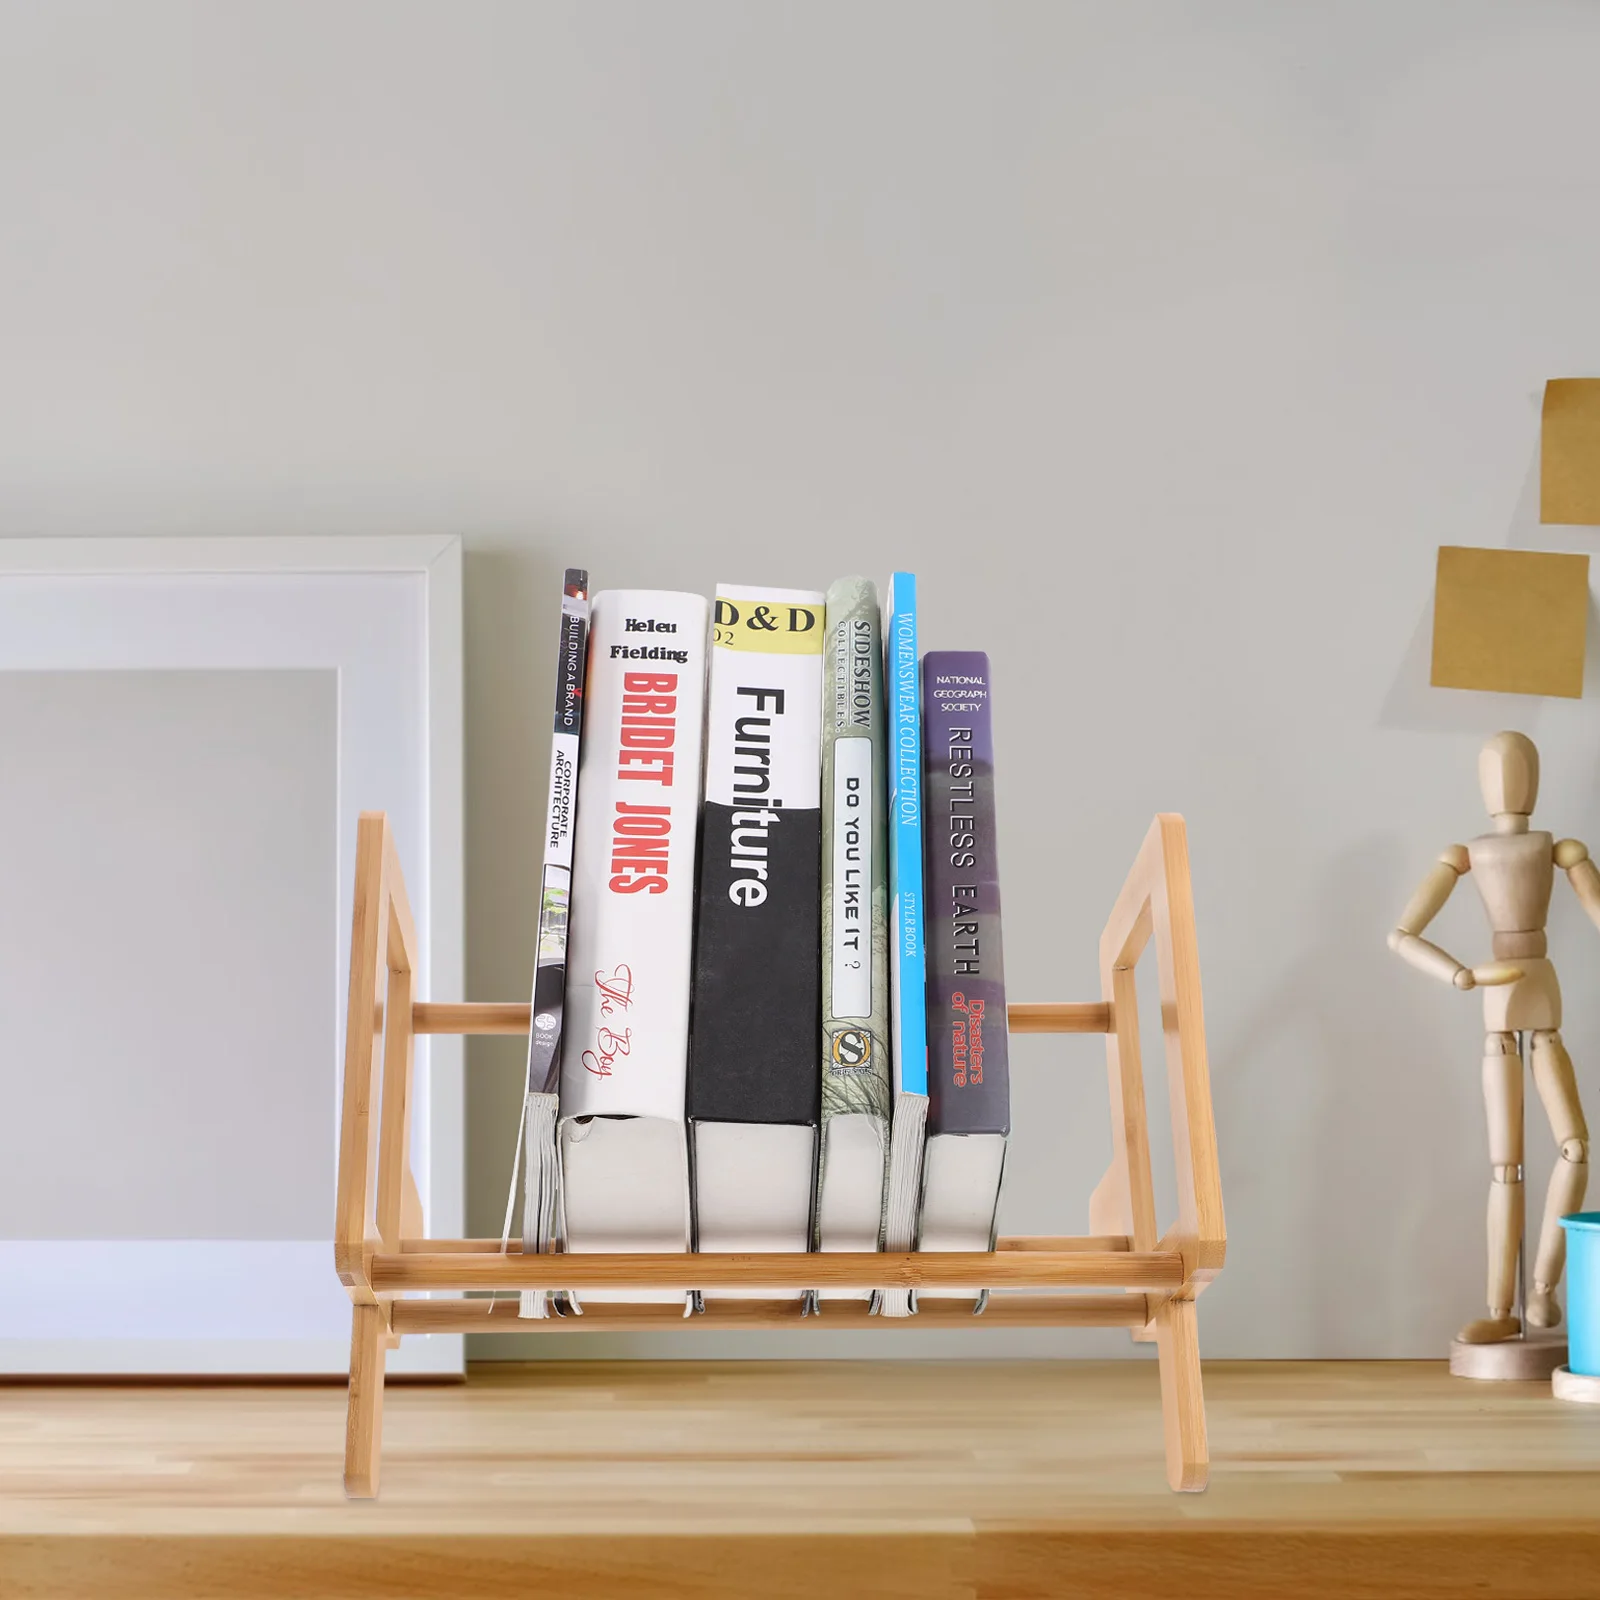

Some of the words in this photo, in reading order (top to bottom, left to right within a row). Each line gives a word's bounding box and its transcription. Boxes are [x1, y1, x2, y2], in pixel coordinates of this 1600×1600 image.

[567, 615, 580, 671] BUILDING
[714, 600, 739, 626] D
[746, 606, 779, 631] &
[786, 607, 815, 632] D
[566, 673, 575, 681] A
[610, 645, 688, 664] Fielding
[853, 621, 871, 728] SIDESHOW
[898, 613, 915, 723] WOMENSWEAR
[936, 676, 986, 685] NATIONAL
[563, 683, 576, 726] BRAND
[933, 689, 987, 698] GEOGRAPH
[941, 702, 982, 711] SOCIETY
[618, 671, 678, 786] BRIDET
[550, 749, 564, 848] ARCHITECTURE
[560, 760, 572, 837] CORPORATE
[728, 686, 785, 907] Furniture
[846, 778, 860, 807] DO
[899, 727, 917, 826] COLLECTION
[948, 727, 976, 868] RESTLESS
[609, 802, 671, 894] JONES
[844, 817, 860, 860] YOU
[844, 870, 860, 920] LIKE
[843, 929, 859, 950] IT
[951, 884, 980, 975] EARTH
[594, 964, 635, 1018] The
[951, 991, 968, 1014] of
[581, 1026, 633, 1081] Boy
[951, 1021, 968, 1088] nature
[968, 999, 985, 1084] Disasters
